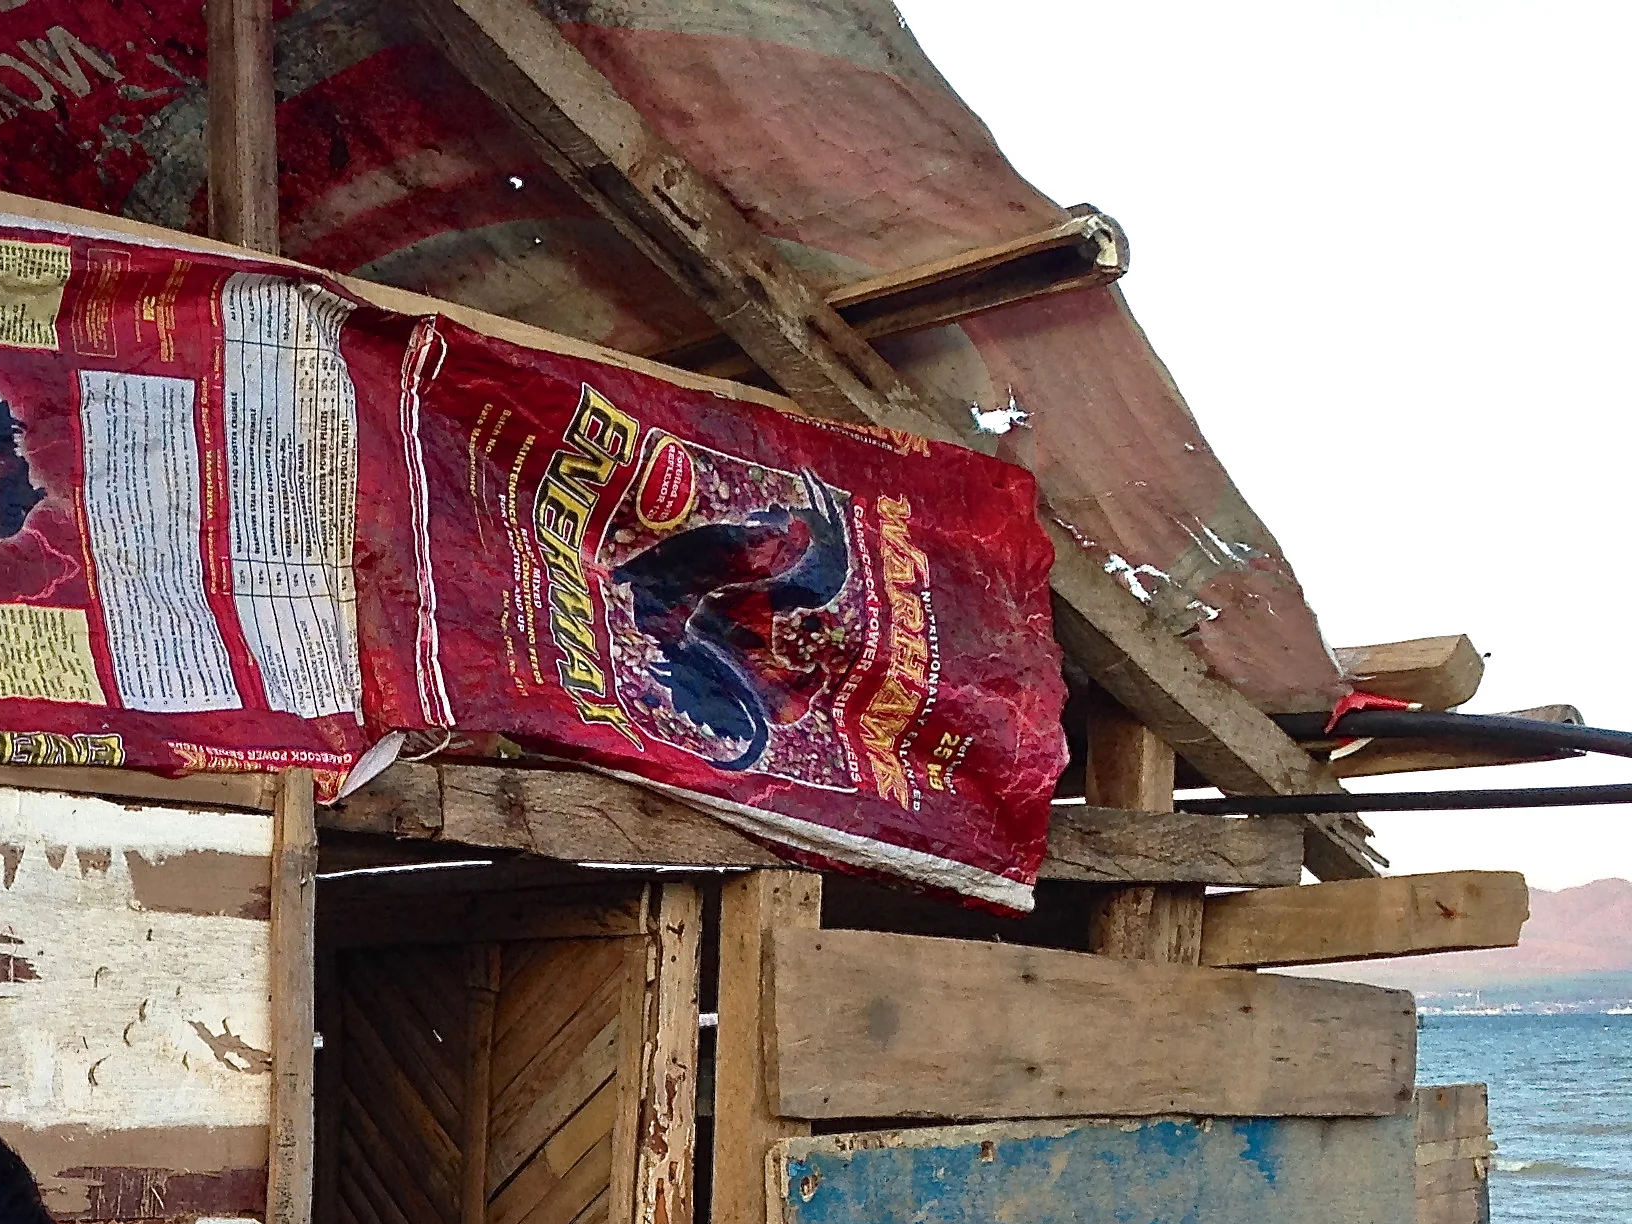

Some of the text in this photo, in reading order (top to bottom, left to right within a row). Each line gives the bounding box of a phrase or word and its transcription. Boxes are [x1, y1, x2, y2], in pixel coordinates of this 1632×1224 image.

[509, 434, 536, 527] MAINTENANCE
[531, 567, 543, 608] MIXED
[533, 382, 644, 751] ENERMAX
[513, 586, 523, 611] AND
[515, 614, 526, 633] UP
[856, 603, 879, 672] POWER
[859, 493, 930, 811] WARHAWK
[917, 591, 941, 726] NUTRITIONALLY
[246, 749, 287, 759] POWER
[933, 731, 960, 760] 25
